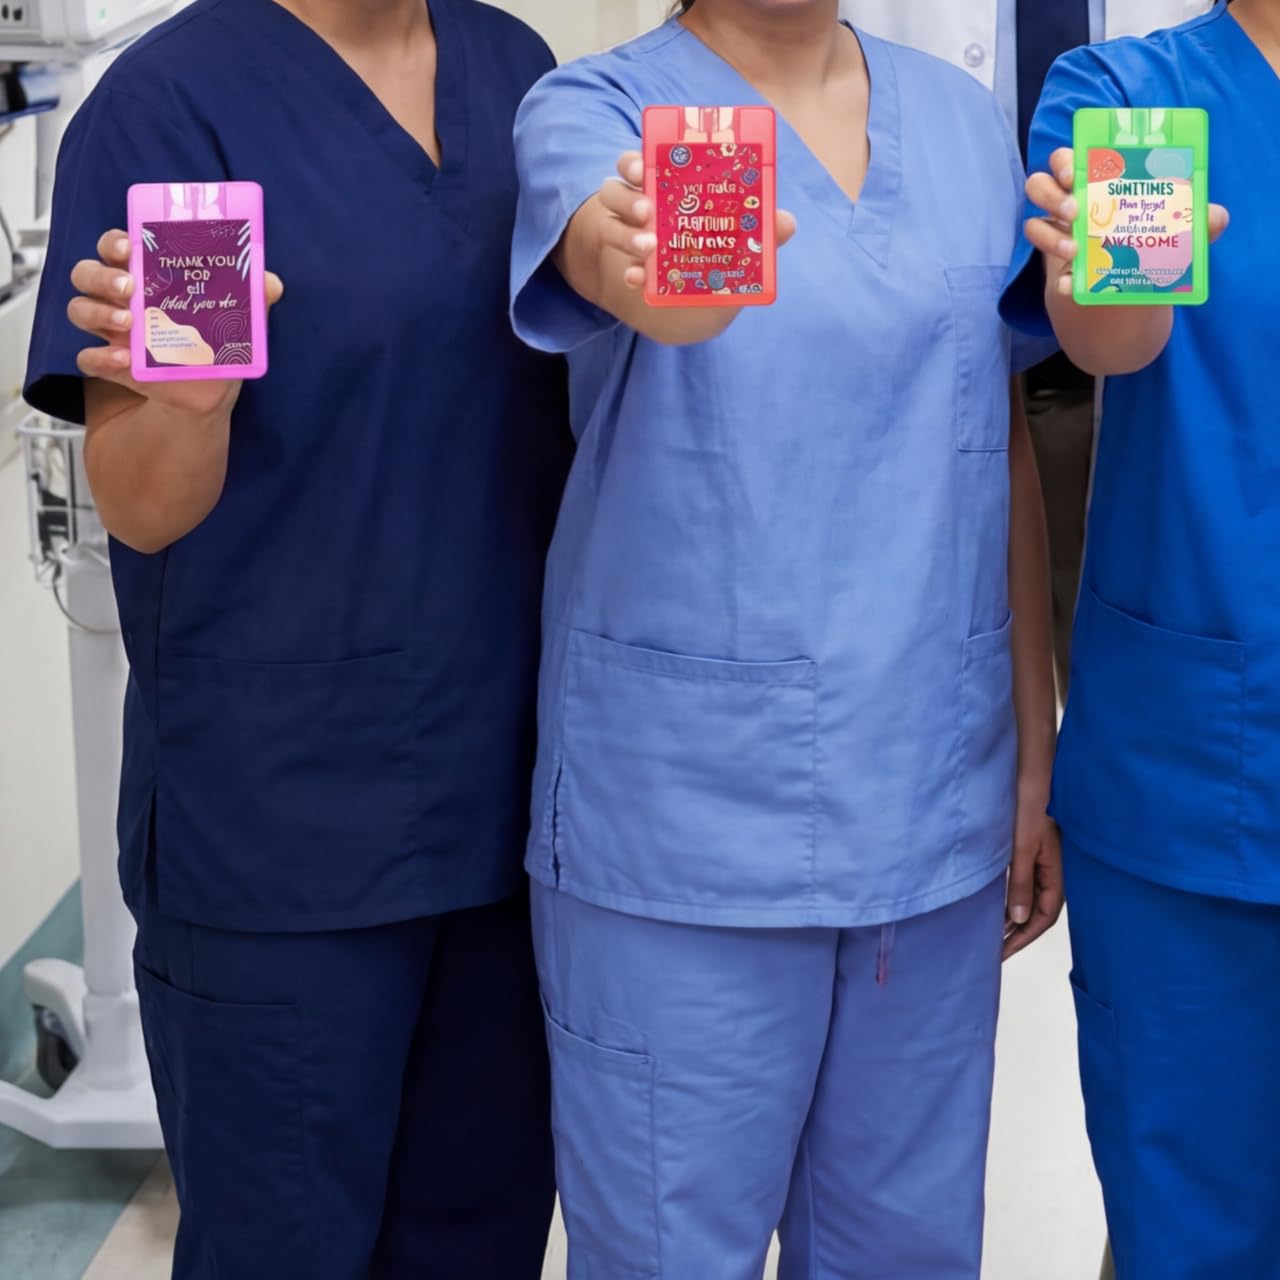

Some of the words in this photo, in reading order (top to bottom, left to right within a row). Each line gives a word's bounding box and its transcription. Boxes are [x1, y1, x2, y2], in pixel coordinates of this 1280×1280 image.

[1101, 235, 1179, 249] AWESOME
[159, 255, 204, 269] THANK
[207, 255, 236, 267] YOU
